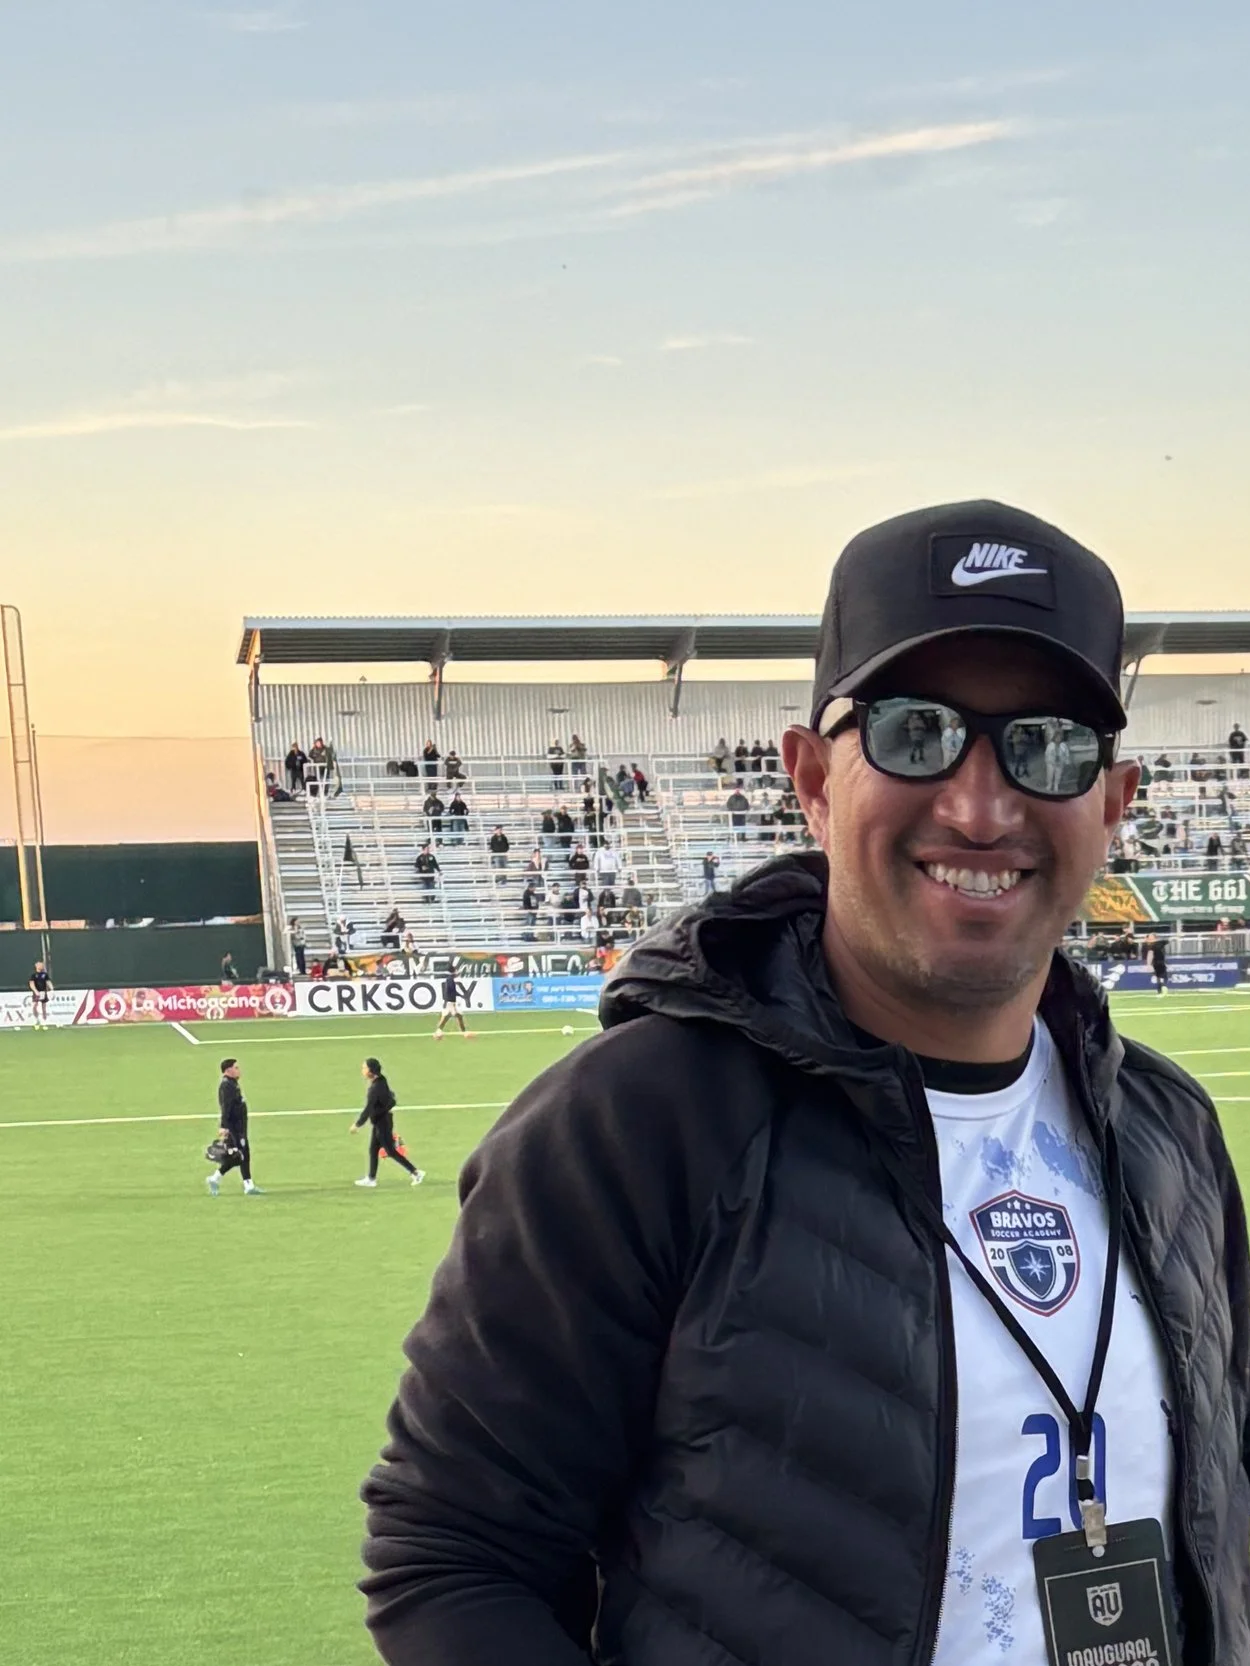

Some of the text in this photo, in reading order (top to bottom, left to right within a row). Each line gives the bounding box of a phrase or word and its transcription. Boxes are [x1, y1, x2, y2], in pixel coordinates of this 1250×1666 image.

[964, 542, 1028, 569] NIKE
[1152, 878, 1248, 902] THE 661
[132, 993, 261, 1012] La Michoacana
[990, 1211, 1056, 1229] BRAVOS
[990, 1229, 1061, 1238] SOCCER ACADEMY
[990, 1247, 1005, 1260] 20
